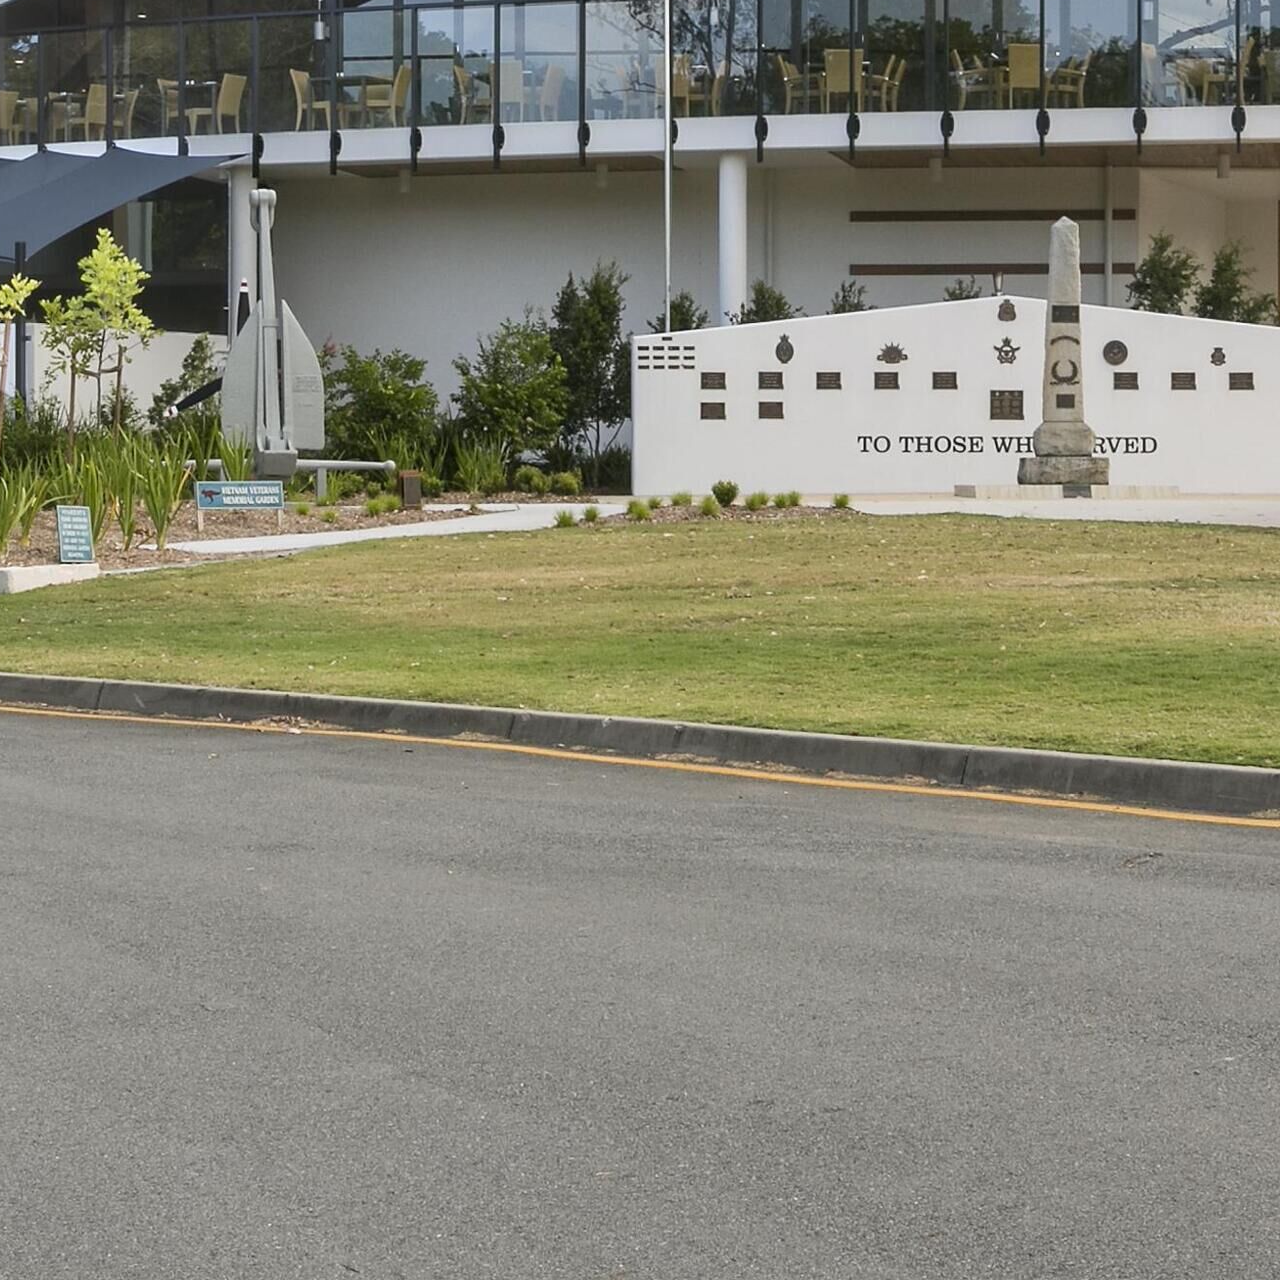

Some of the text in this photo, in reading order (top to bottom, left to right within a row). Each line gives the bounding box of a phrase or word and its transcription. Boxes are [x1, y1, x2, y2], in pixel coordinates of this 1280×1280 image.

[857, 435, 1158, 454] TO THOSE WH RVED
[221, 486, 248, 495] VIETNAM
[223, 495, 280, 505] MEMORIAL GARDEN
